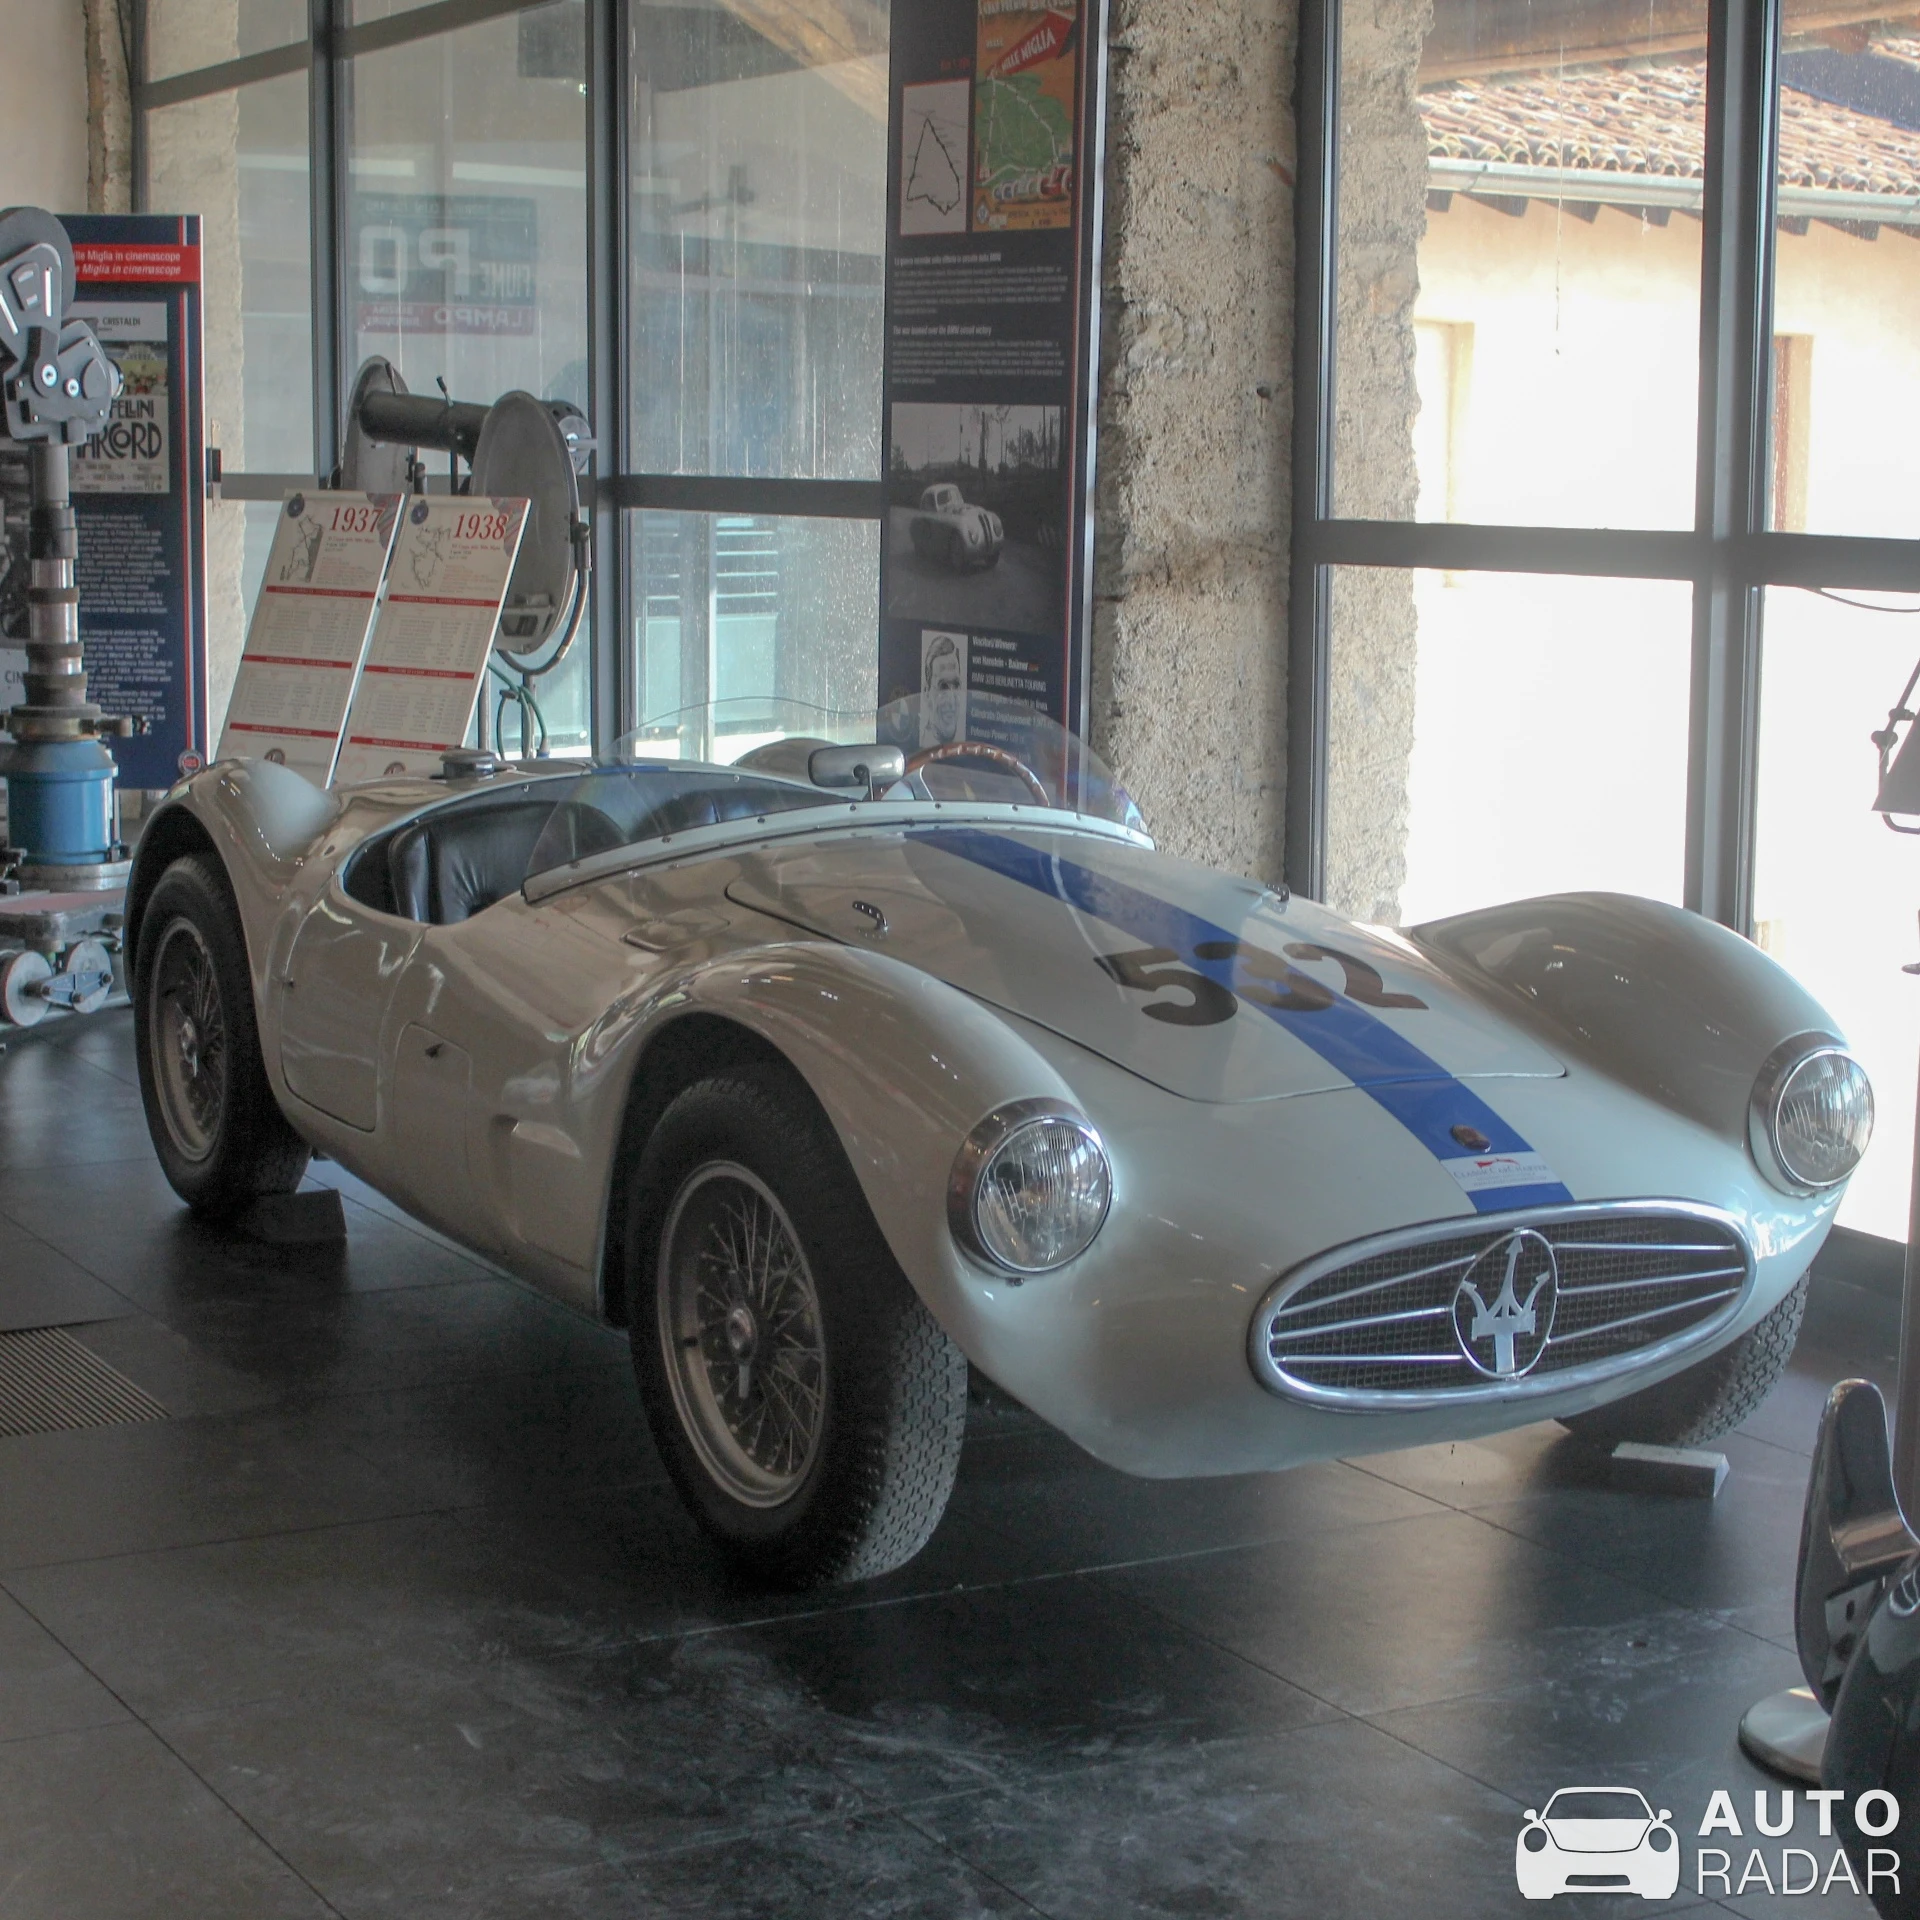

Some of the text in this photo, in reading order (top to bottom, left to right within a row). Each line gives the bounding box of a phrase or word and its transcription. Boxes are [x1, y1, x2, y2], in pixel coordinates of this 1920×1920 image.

[87, 250, 113, 262] Miglia
[115, 251, 123, 261] in
[125, 251, 181, 263] cinemascope
[82, 263, 110, 276] Miglia
[112, 264, 121, 275] in
[123, 264, 181, 277] cinemascope
[102, 316, 141, 326] CRISTALDI
[109, 399, 154, 419] FELLINI
[329, 506, 386, 533] 1937
[453, 513, 509, 540] 1938
[1094, 941, 1430, 1026] 532
